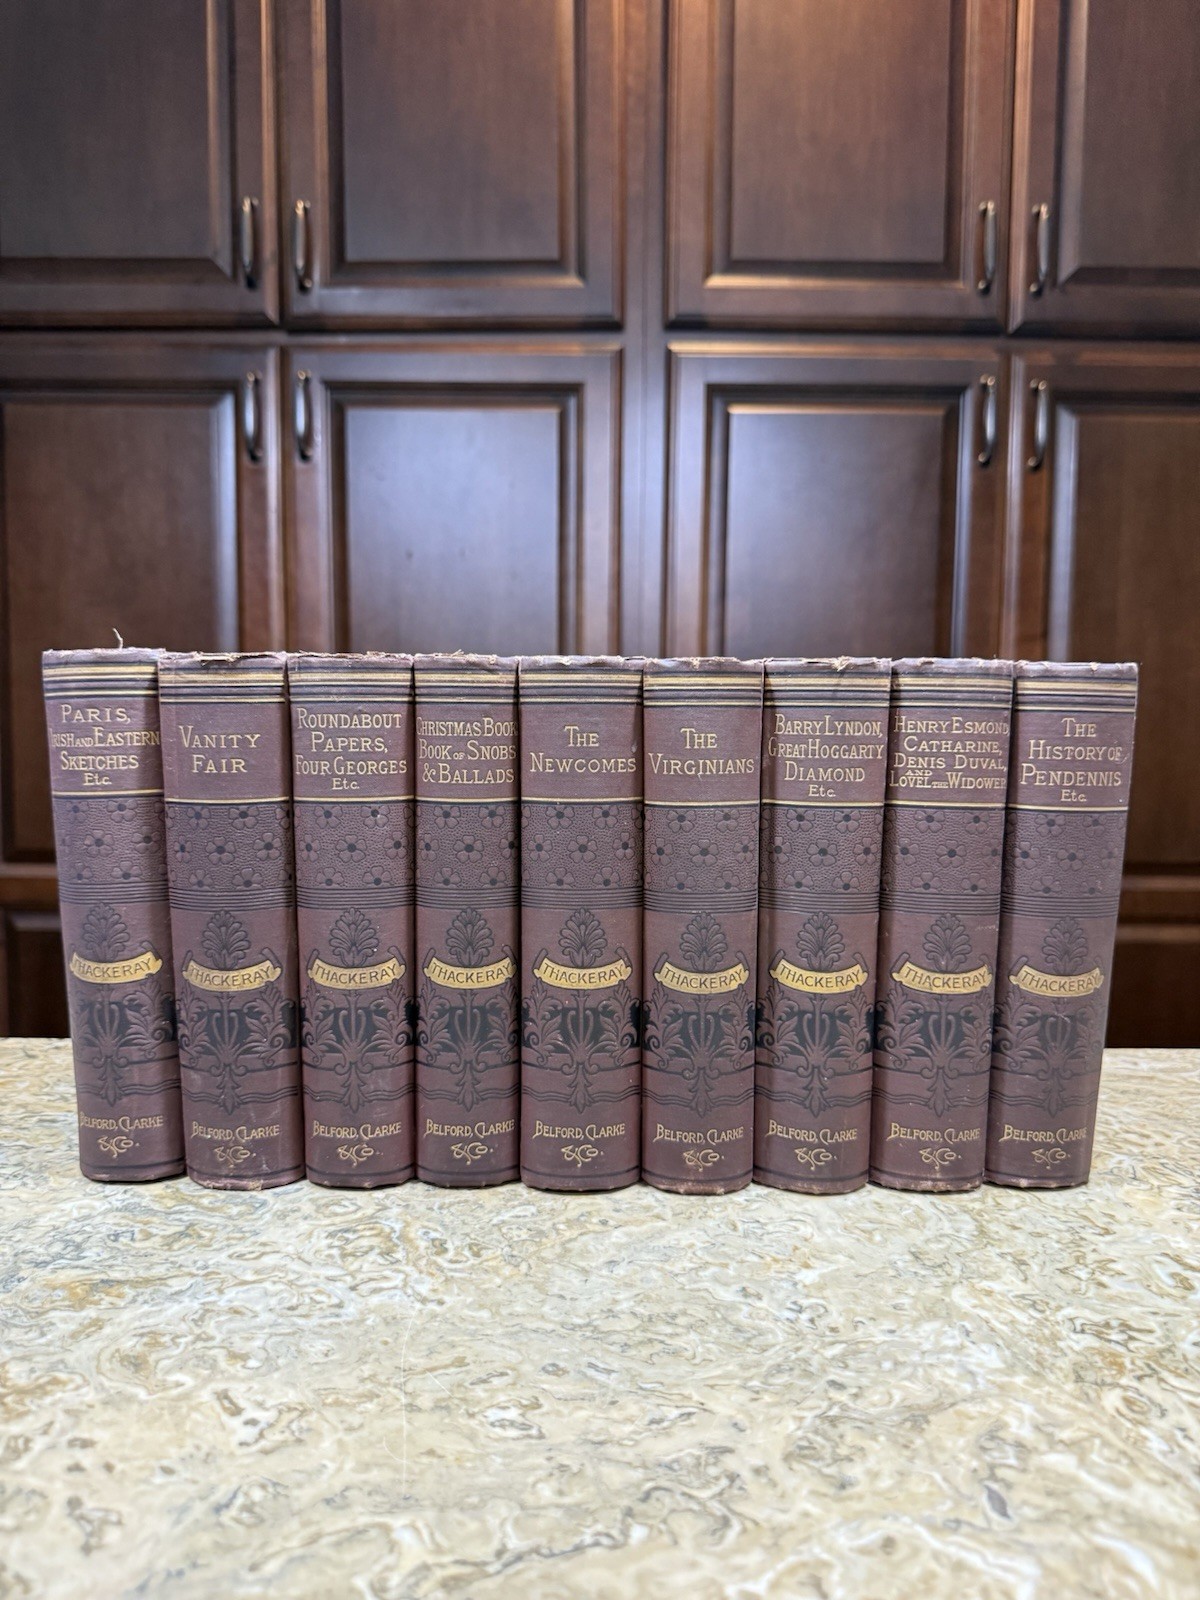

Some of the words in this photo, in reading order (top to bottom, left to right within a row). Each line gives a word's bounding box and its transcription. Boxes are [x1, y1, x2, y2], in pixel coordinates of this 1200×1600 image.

[61, 704, 131, 724] PARIS,
[296, 708, 402, 729] ROUNDABOUT
[893, 715, 950, 733] HENRY
[416, 716, 482, 737] CHRISTMAS
[564, 725, 600, 747] THE
[774, 713, 823, 736] BARRY
[824, 715, 883, 738] LYNDON,
[1061, 717, 1097, 738] THE
[92, 726, 160, 747] EASTERN
[178, 725, 261, 748] VANITY
[311, 731, 388, 753] PAPERS,
[680, 728, 718, 749] THE
[904, 735, 1003, 756] CATHARINE,
[418, 738, 452, 760] BOOK
[467, 740, 517, 760] SNOBS
[768, 736, 807, 759] GREAT
[807, 738, 884, 759] HOGGARTY
[1028, 739, 1107, 761] HISTORY
[1107, 746, 1123, 761] OF
[61, 750, 139, 770] SKETCHES
[192, 754, 248, 774] FAIR
[295, 755, 332, 775] FOUR
[334, 756, 408, 775] GEORGES
[529, 752, 637, 773] NEWCOMES
[648, 752, 755, 775] VIRGINIANS
[893, 752, 946, 769] DENIS
[953, 754, 1007, 772] DUVAL,
[438, 763, 515, 784] BALLADS
[784, 761, 866, 782] DIAMOND
[889, 770, 932, 788] LOVEL
[905, 769, 933, 777] AND
[1019, 763, 1122, 786] PENDENNIS
[73, 955, 153, 978] THACKERAY
[188, 964, 271, 987] THACKERAY
[313, 963, 397, 985] THACKERAY
[431, 961, 514, 984] THACKERAY
[542, 962, 625, 984] THACKERAY
[779, 963, 862, 988] THACKERAY
[664, 967, 743, 989] THACKERAY
[903, 968, 987, 989] THACKERAY
[1021, 971, 1100, 991] THACKERAY
[119, 1113, 164, 1132] CLARKE
[191, 1121, 235, 1141] BELFORD,
[235, 1124, 280, 1140] CLARKE
[312, 1119, 358, 1139] BELFORD,
[359, 1121, 402, 1139] CLARKE
[423, 1119, 474, 1138] BELFORD,
[474, 1119, 515, 1138] CLARKE
[533, 1120, 585, 1140] BELFORD,
[585, 1123, 625, 1139] CLARKE
[653, 1123, 706, 1143] BELFORD,
[706, 1126, 745, 1143] CLARKE
[765, 1119, 818, 1142] BELFORD,
[819, 1128, 858, 1143] CLARKE
[887, 1122, 943, 1143] BELFORD,
[944, 1127, 981, 1144] CLARKE
[999, 1124, 1055, 1144] BELFORD,
[1056, 1127, 1088, 1144] CLARKE
